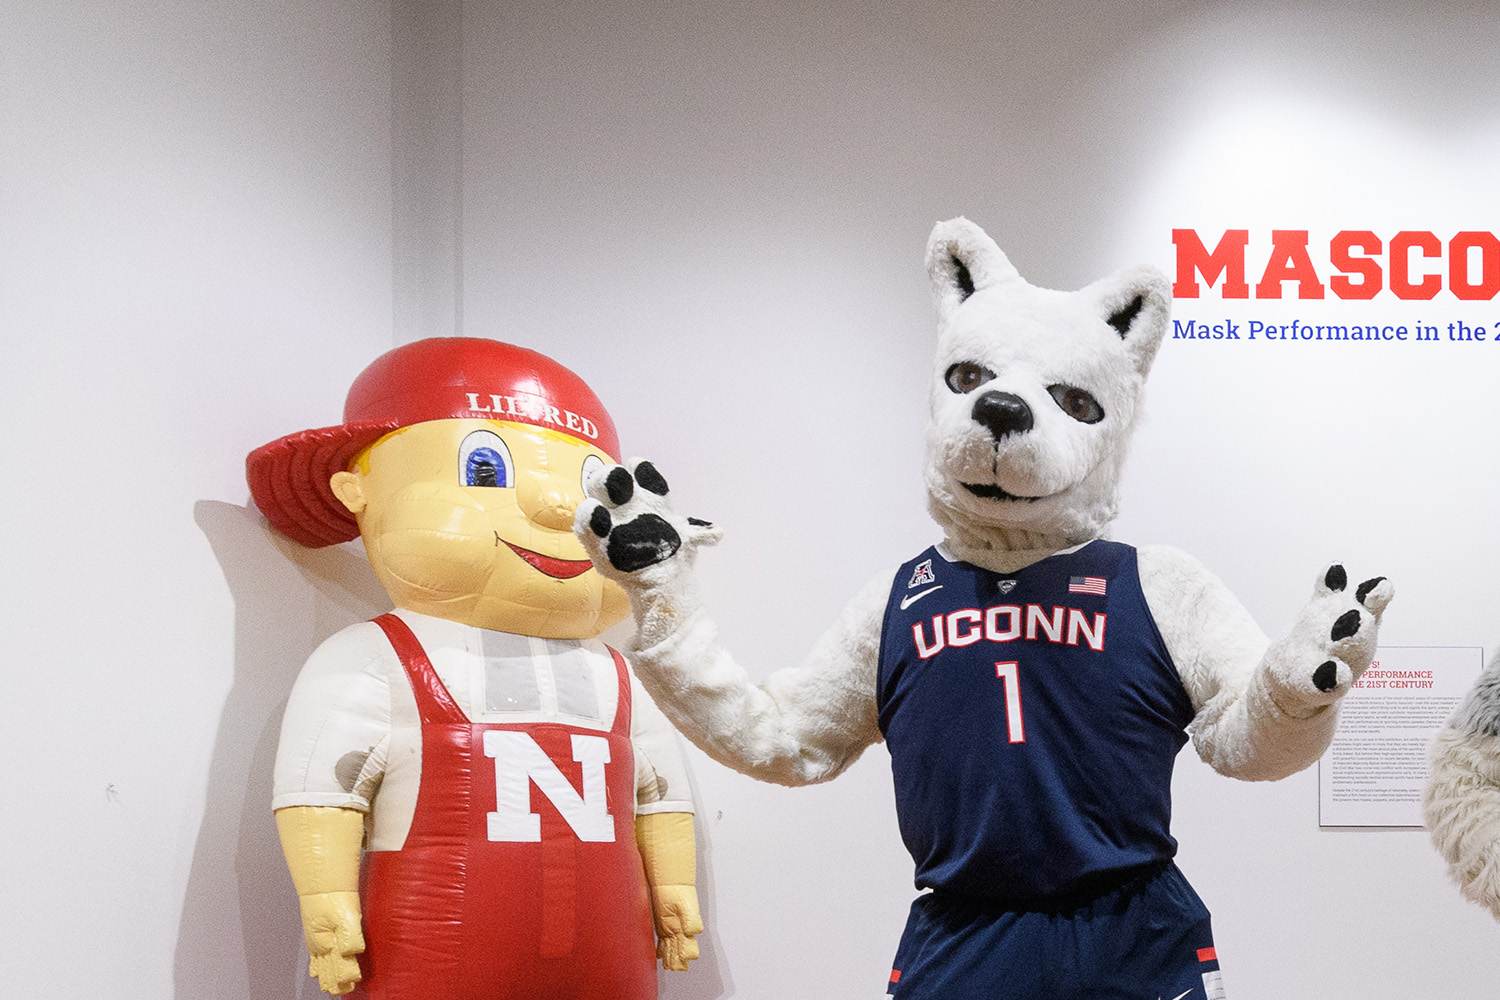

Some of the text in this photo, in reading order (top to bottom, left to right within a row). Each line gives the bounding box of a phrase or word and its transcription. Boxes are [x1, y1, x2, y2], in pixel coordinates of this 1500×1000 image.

[1172, 318, 1241, 340] Mask
[1247, 319, 1409, 342] Performance
[1415, 319, 1440, 341] in
[1447, 320, 1487, 342] the
[541, 403, 599, 439] RED
[911, 602, 1108, 660] UCONN
[994, 660, 1026, 744] 1
[1366, 680, 1387, 688] 21ST
[1389, 680, 1434, 688] CENTURY
[482, 730, 617, 843] N
